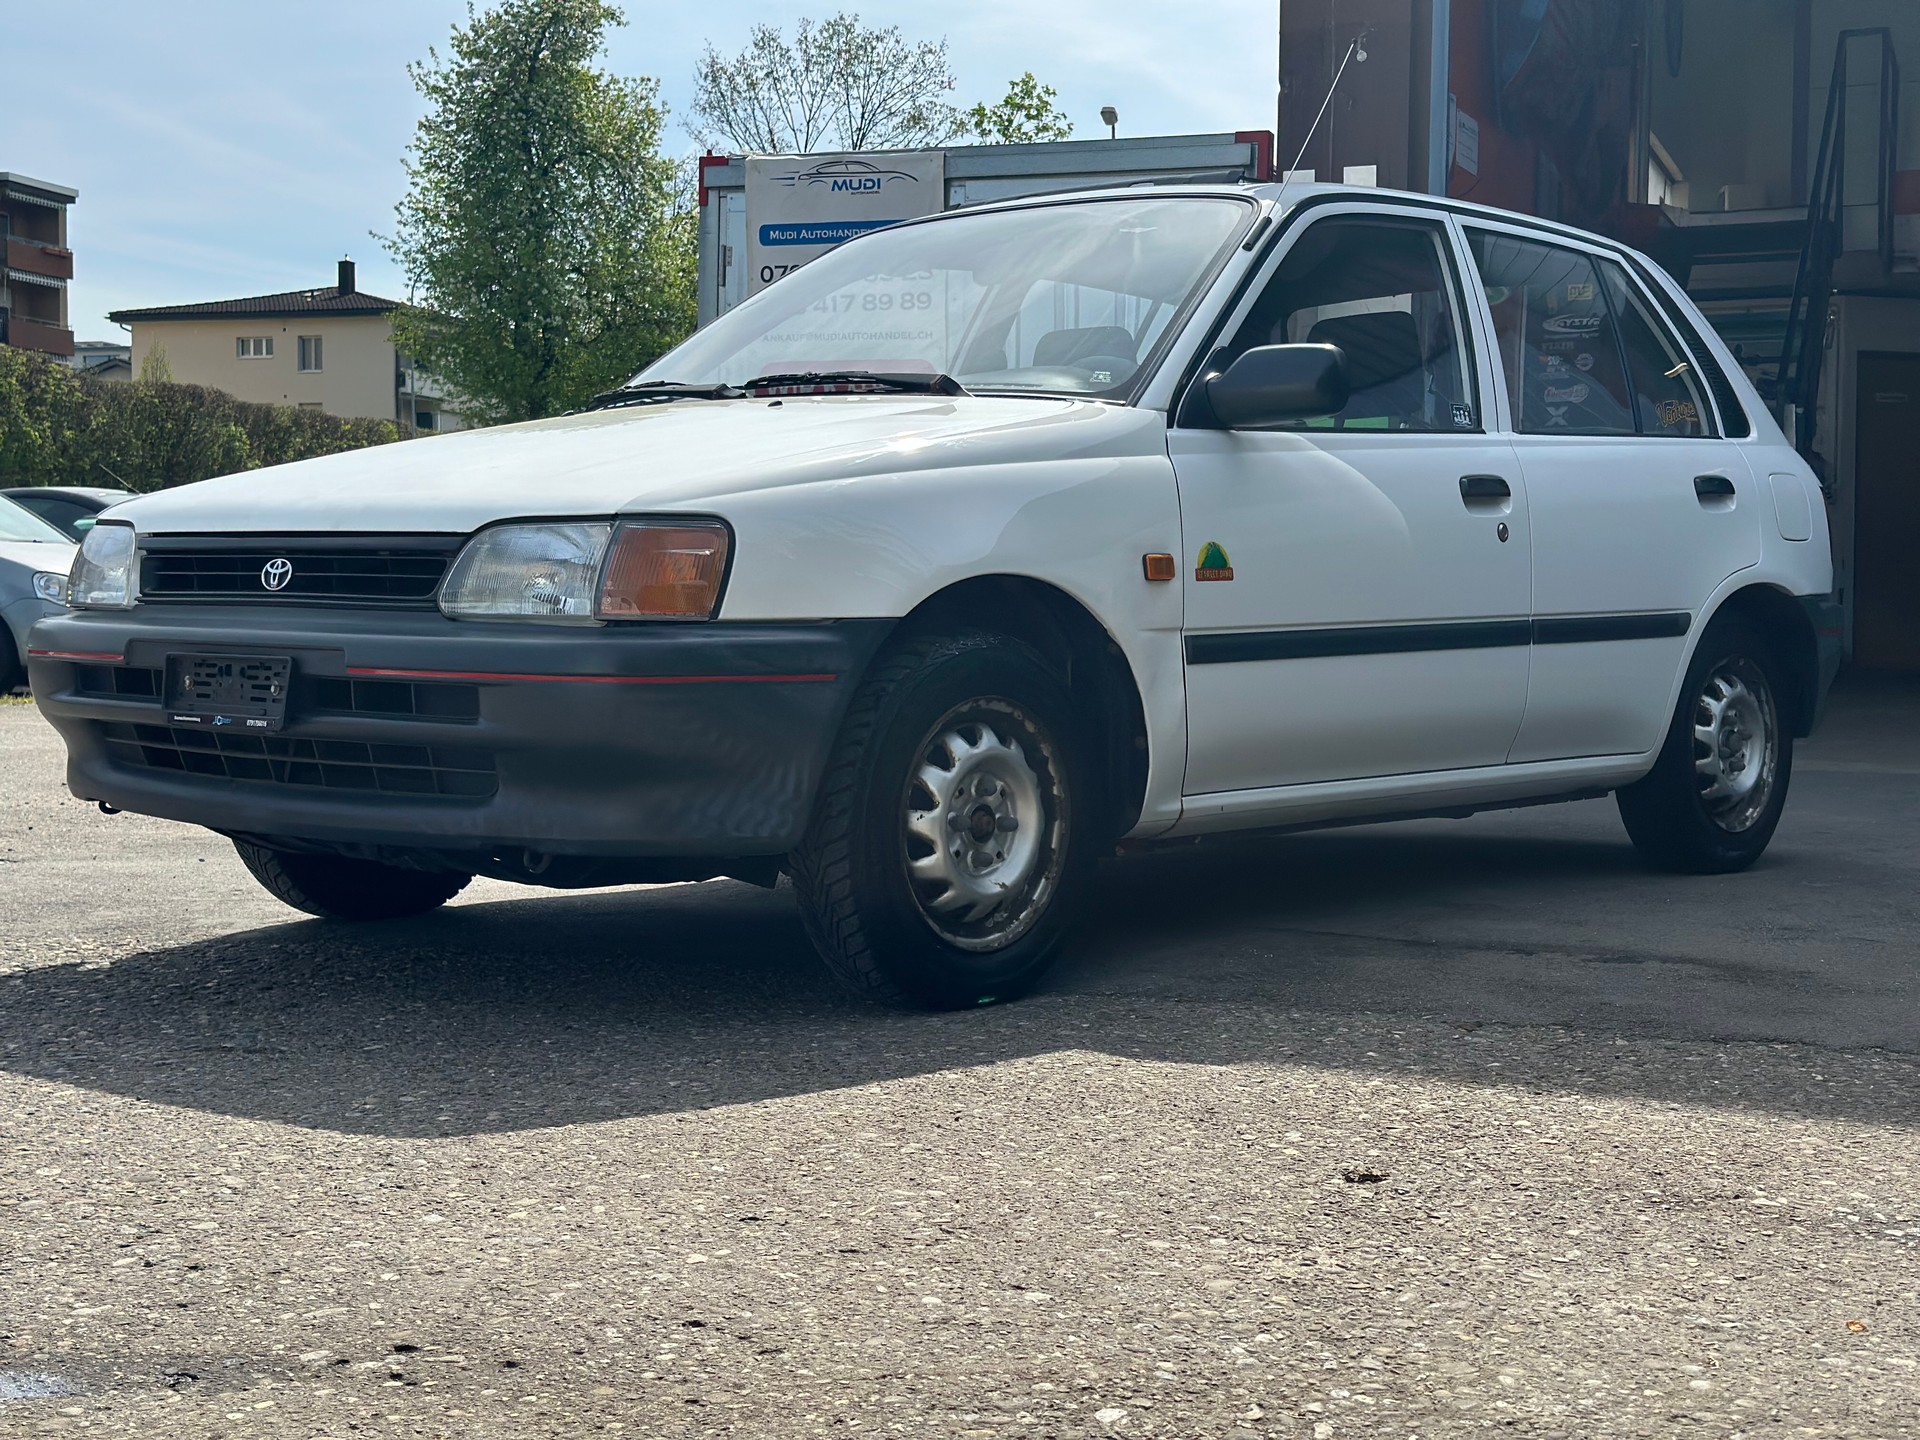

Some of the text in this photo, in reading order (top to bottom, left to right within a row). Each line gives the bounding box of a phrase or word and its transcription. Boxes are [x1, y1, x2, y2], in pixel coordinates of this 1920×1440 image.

[831, 178, 881, 191] MUDI
[800, 229, 873, 239] AUTOHAND
[812, 292, 932, 313] 417 89 89
